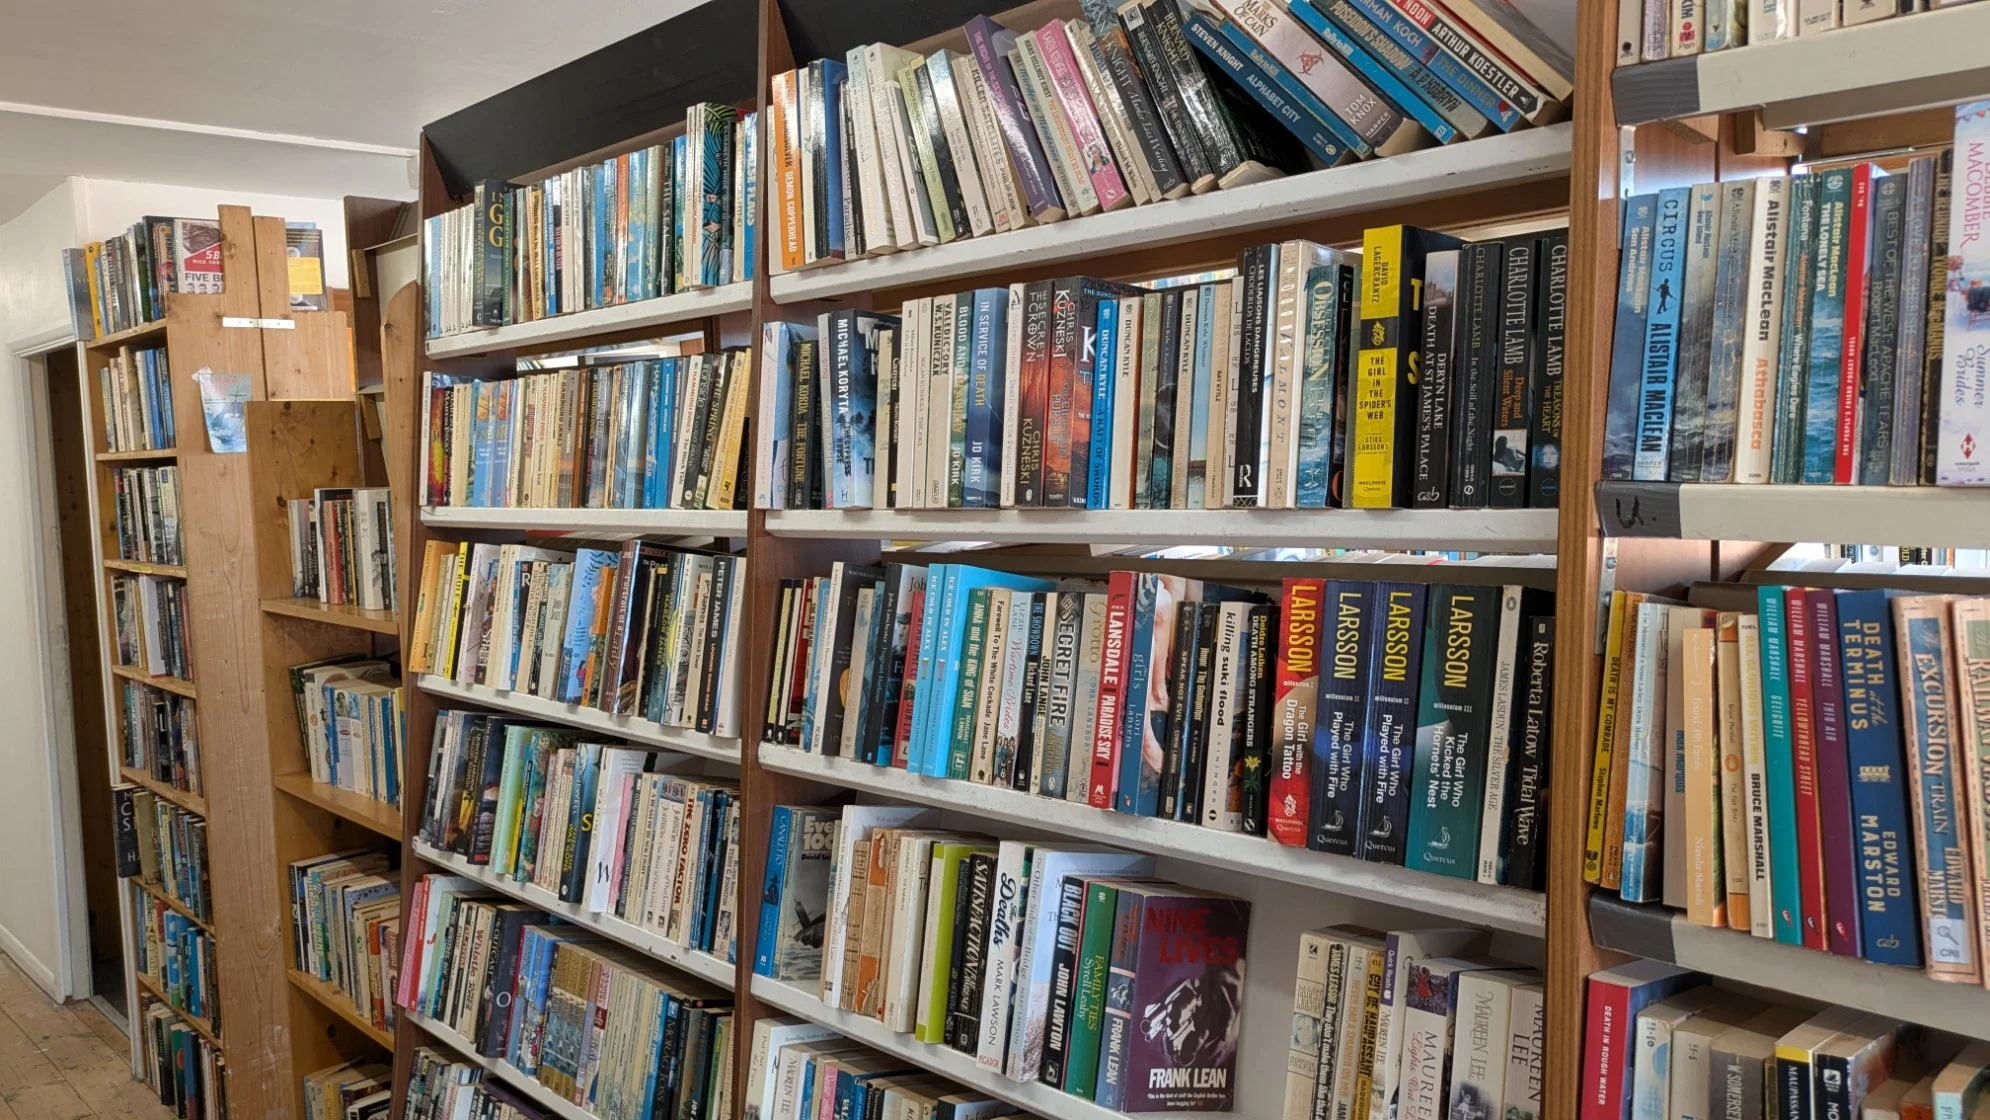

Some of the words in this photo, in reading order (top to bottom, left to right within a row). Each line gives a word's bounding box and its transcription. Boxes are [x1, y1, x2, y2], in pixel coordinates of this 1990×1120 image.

[1232, 6, 1248, 23] OF
[1247, 18, 1274, 37] CAIN
[1242, 0, 1278, 28] MARKS
[1403, 2, 1432, 24] NOON
[1191, 23, 1218, 49] STEVEN
[1215, 43, 1245, 72] KNIGHT
[1393, 22, 1422, 47] KOCH
[1431, 22, 1468, 55] ARTHUR
[1467, 52, 1519, 97] KOESTLER
[1247, 73, 1285, 112] ALPHABET
[1281, 104, 1301, 123] CITY
[1344, 94, 1368, 115] TOM
[1350, 96, 1377, 125] KNOX
[1365, 112, 1390, 137] HARPER
[785, 171, 794, 200] DEMON
[1960, 142, 1982, 249] MACOMBER
[787, 201, 797, 252] COPPERHEAD
[1659, 199, 1678, 272] CIRCUS
[1764, 200, 1781, 262] Alistair
[185, 273, 209, 281] FIVE
[1371, 246, 1382, 303] LAGERCRANTZ
[1381, 262, 1389, 285] DAVID
[1506, 248, 1528, 325] CHARLOTTE
[981, 302, 990, 311] IN
[1254, 282, 1263, 323] LIAISONS
[1759, 266, 1775, 341] MacLean
[838, 319, 847, 368] MICHAEL
[978, 315, 989, 356] SERVICE
[1026, 303, 1038, 362] CROWN
[1036, 303, 1046, 360] SECRET
[1426, 306, 1436, 348] DEATH
[800, 344, 811, 381] MICHAEL
[1252, 326, 1261, 393] DANGEREUSES
[1425, 352, 1435, 366] AT
[1504, 330, 1524, 364] LAMB
[1646, 323, 1672, 383] ALISTAIR
[978, 360, 987, 371] OF
[1424, 368, 1434, 382] ST
[1436, 353, 1446, 395] DERYN
[1503, 369, 1513, 395] Silent
[1955, 348, 1974, 405] Brides
[687, 371, 698, 407] HAMMOND
[799, 385, 810, 414] KORDA
[838, 371, 849, 414] KORYTA
[975, 374, 986, 405] DEATH
[1359, 401, 1391, 409] SPIDER'S
[1512, 377, 1524, 400] Deep
[1751, 358, 1768, 449] Athabasca
[685, 410, 693, 433] INNES
[1368, 412, 1384, 420] WEB
[1421, 385, 1432, 431] JAMES'S
[1434, 398, 1444, 429] LAKE
[1501, 397, 1512, 427] Waters
[1513, 402, 1523, 418] and
[1641, 390, 1665, 452] MACLEAN
[797, 423, 807, 439] THE
[972, 441, 983, 453] JD
[795, 442, 806, 483] FORTUNE
[1020, 419, 1032, 483] KUZNESKI
[1031, 431, 1041, 470] CHRIS
[1419, 434, 1430, 480] PALACE
[971, 457, 981, 482] KIRK
[715, 562, 726, 596] PETER
[710, 598, 722, 638] JAMES
[973, 603, 984, 623] ANNA
[1258, 615, 1267, 645] Deidre
[1287, 585, 1317, 672] LARSSON
[971, 627, 980, 641] and
[1054, 612, 1075, 679] SECRET
[1105, 612, 1124, 683] LANSDALE
[1221, 611, 1236, 652] killing
[1251, 615, 1259, 648] DEATH
[1334, 592, 1361, 679] LARSSON
[1384, 591, 1412, 681] LARSSON
[1444, 595, 1474, 688] LARSSON
[969, 644, 979, 656] the
[1257, 648, 1266, 679] Laiken
[1863, 623, 1885, 686] DEATH
[964, 679, 975, 688] of
[966, 659, 978, 677] KING
[1220, 657, 1230, 685] suki
[1249, 651, 1258, 687] AMONG
[1529, 642, 1548, 705] Roberta
[1608, 657, 1619, 682] DEATH
[1843, 619, 1868, 731] TERMINUS
[961, 690, 973, 708] SIAM
[1050, 684, 1068, 726] FIRE
[1606, 698, 1616, 710] MY
[1607, 685, 1617, 694] IS
[1099, 695, 1114, 739] PARADISE
[1217, 690, 1228, 726] flood
[1246, 689, 1255, 747] STRANGERS
[1284, 699, 1298, 740] Dragon
[1298, 706, 1307, 719] The
[1915, 654, 1946, 776] EXCURSION
[1296, 722, 1308, 741] Girl
[1379, 714, 1392, 753] Played
[1392, 725, 1403, 745] The
[1456, 733, 1468, 754] The
[1525, 709, 1544, 757] Latow
[1601, 713, 1614, 753] COMRADE
[1097, 741, 1111, 759] SKY
[1283, 744, 1296, 779] Tattoo
[1296, 744, 1305, 760] with
[1378, 755, 1389, 779] with
[1390, 747, 1402, 768] Girl
[1429, 726, 1444, 777] Hornets'
[1442, 736, 1456, 778] Kicked
[1295, 763, 1304, 775] the
[1389, 770, 1400, 796] Who
[1454, 757, 1466, 778] Girl
[1520, 765, 1538, 802] Tidal
[1376, 781, 1387, 803] Fire
[1427, 780, 1439, 808] Nest
[1440, 781, 1452, 800] the
[1452, 781, 1463, 807] Who
[1751, 772, 1762, 812] BRUCE
[1929, 782, 1947, 833] TRAIN
[685, 796, 696, 820] THE
[682, 824, 694, 855] ZERO
[1516, 807, 1535, 845] Wave
[1753, 815, 1765, 881] MARSHALL
[1859, 815, 1886, 913] MARSTON
[1882, 831, 1901, 897] EDWARD
[674, 857, 689, 904] FACTOR
[965, 860, 988, 973] SATISFACTION
[994, 872, 1016, 948] Deaths
[1060, 884, 1082, 924] BLACK
[1058, 927, 1076, 954] OUT
[1056, 963, 1070, 996] JOHN
[1091, 955, 1104, 998] FAMILY
[1050, 999, 1067, 1050] LAWTON
[1088, 1001, 1100, 1030] TIES
[1470, 992, 1493, 1052] MAUREEN
[1602, 1006, 1612, 1031] DEATH
[663, 1018, 678, 1065] MORAG
[1108, 1018, 1123, 1053] FRANK
[1602, 1035, 1611, 1043] IN
[1106, 1055, 1120, 1084] LEAN
[1148, 1069, 1192, 1089] FRANK
[1194, 1068, 1227, 1088] LEAN
[1468, 1058, 1488, 1081] LEE
[1600, 1047, 1610, 1077] ROUGH
[656, 1068, 670, 1102] JOSS
[1598, 1079, 1607, 1105] WATER
